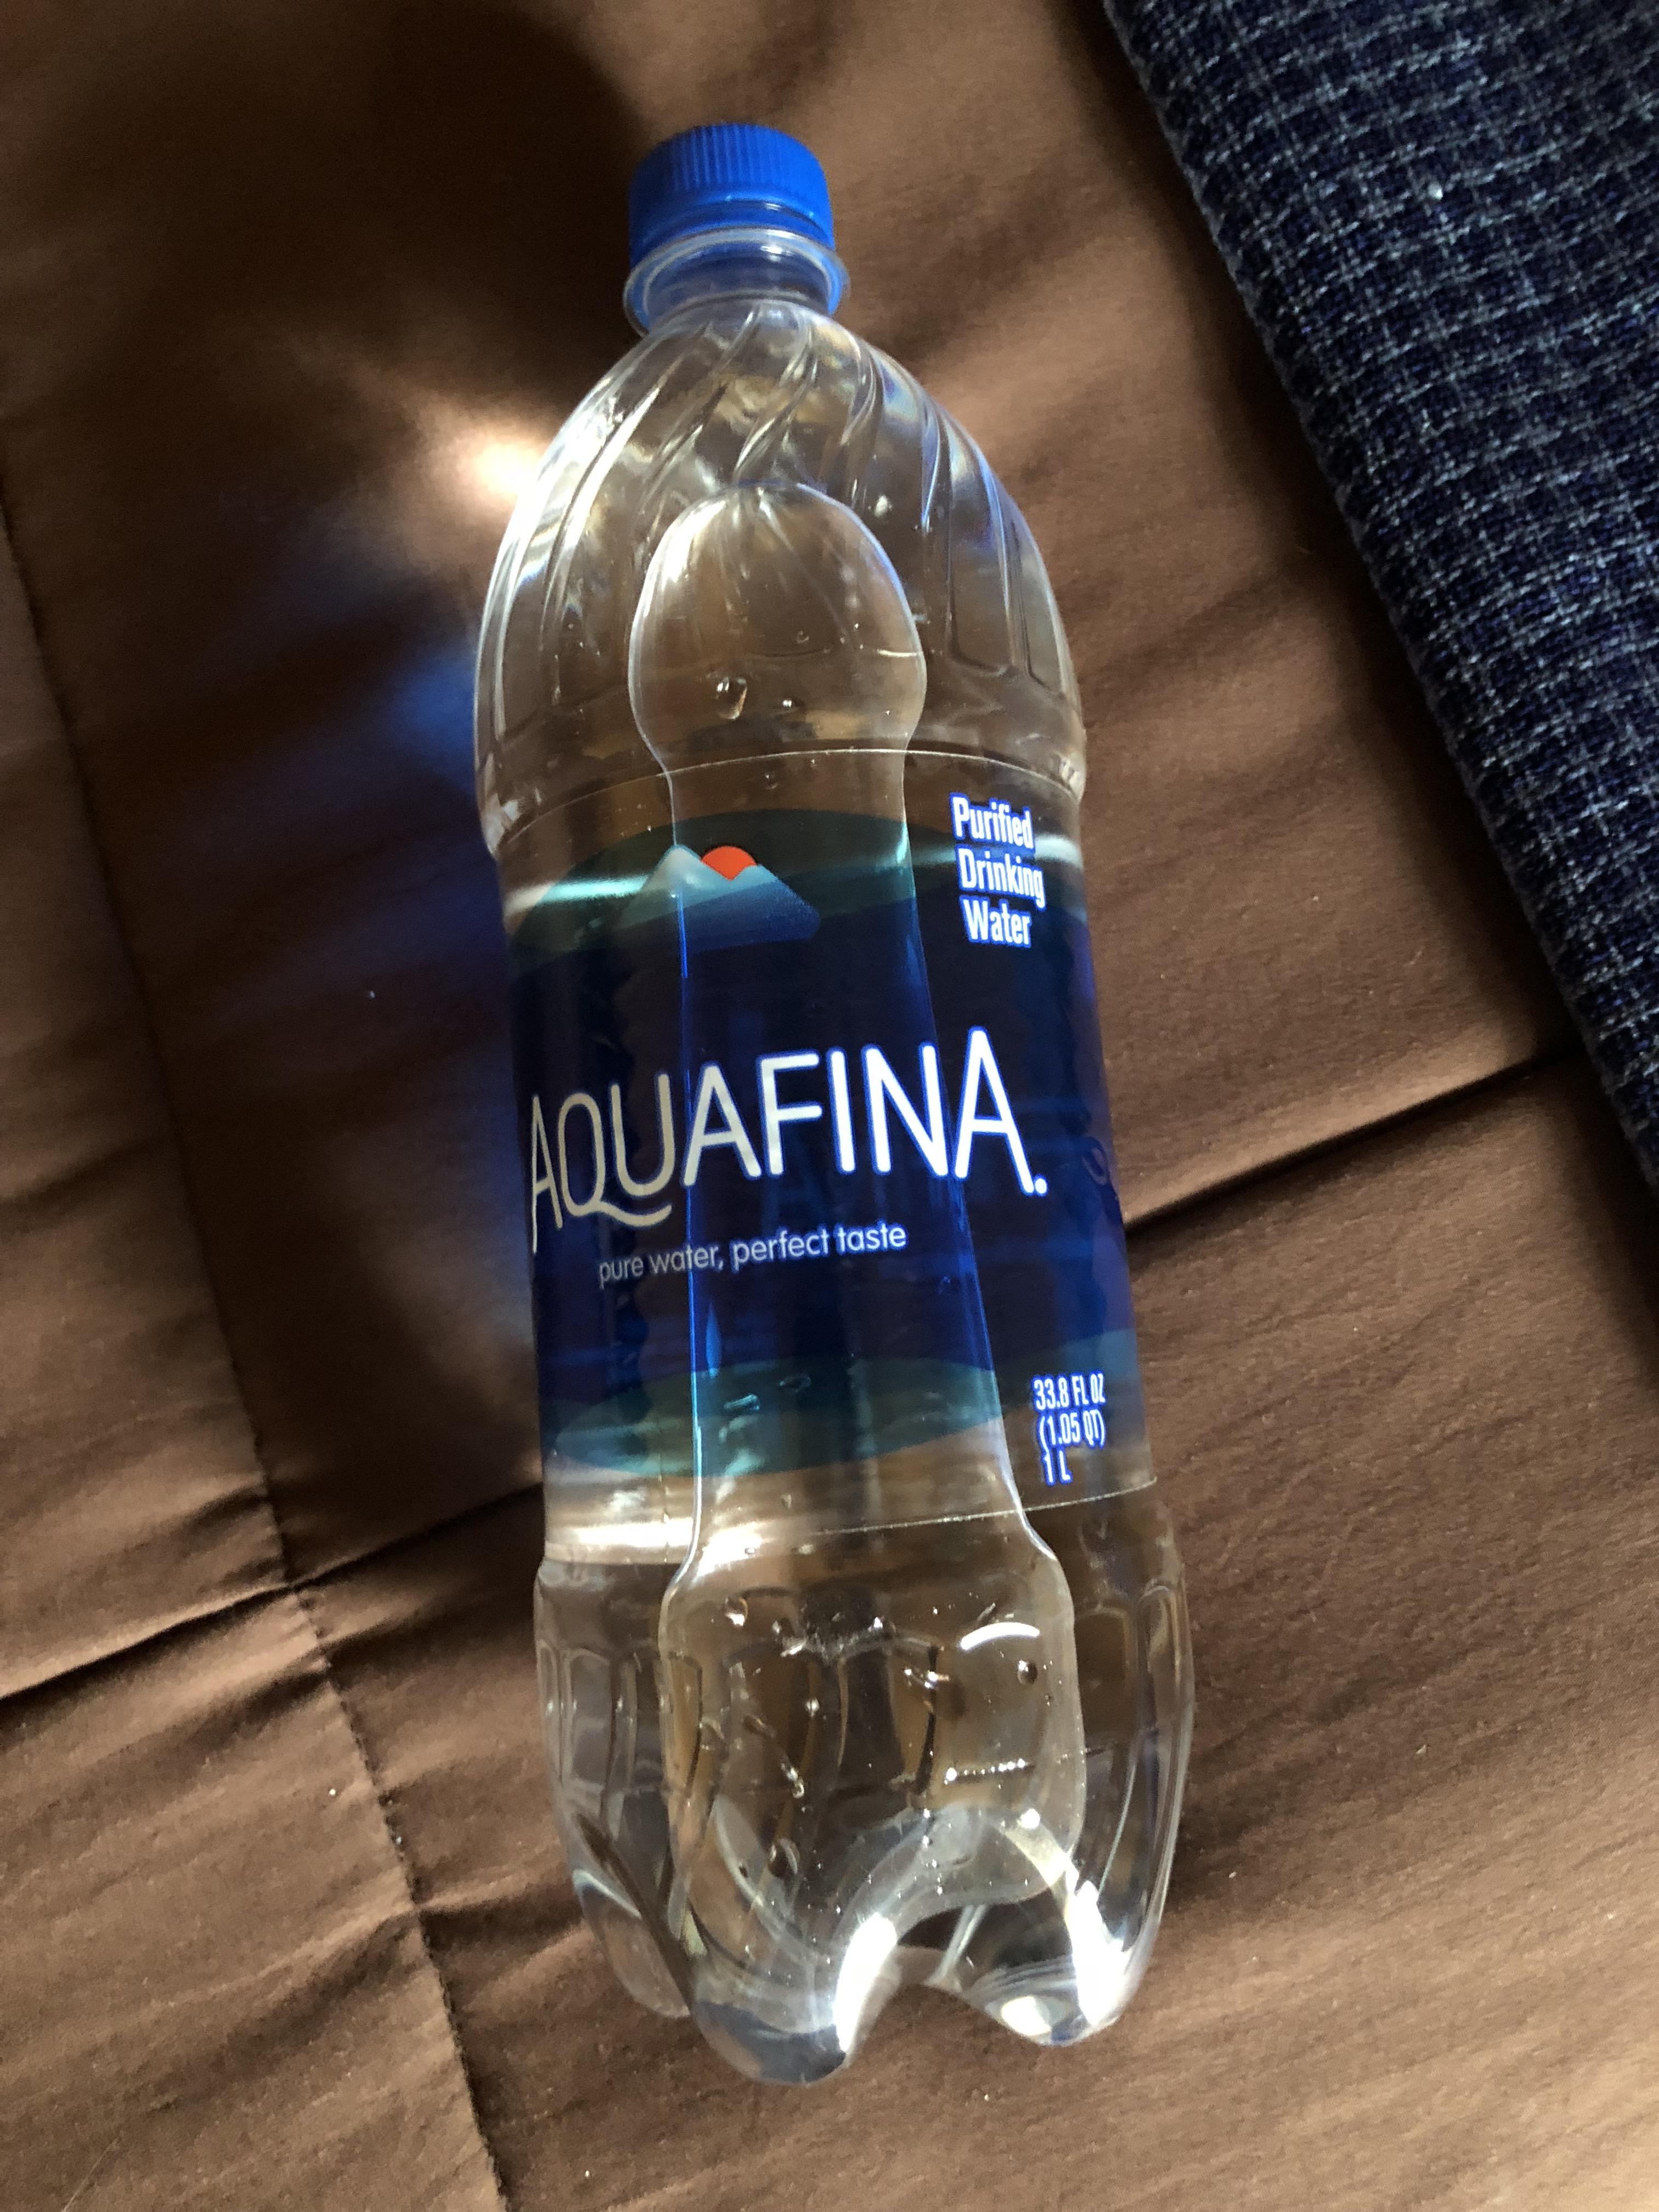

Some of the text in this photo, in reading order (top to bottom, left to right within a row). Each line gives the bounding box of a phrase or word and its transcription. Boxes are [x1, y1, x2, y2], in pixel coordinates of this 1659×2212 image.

[952, 795, 1034, 849] Purified
[957, 848, 1046, 909] Drinking
[963, 898, 1031, 945] Water
[598, 1219, 908, 1289] pure water, perfect taste
[1034, 1372, 1106, 1410] 33.8 FL OZ
[1039, 1408, 1105, 1455] (1.05 QT)
[1044, 1449, 1071, 1483] 1 L
